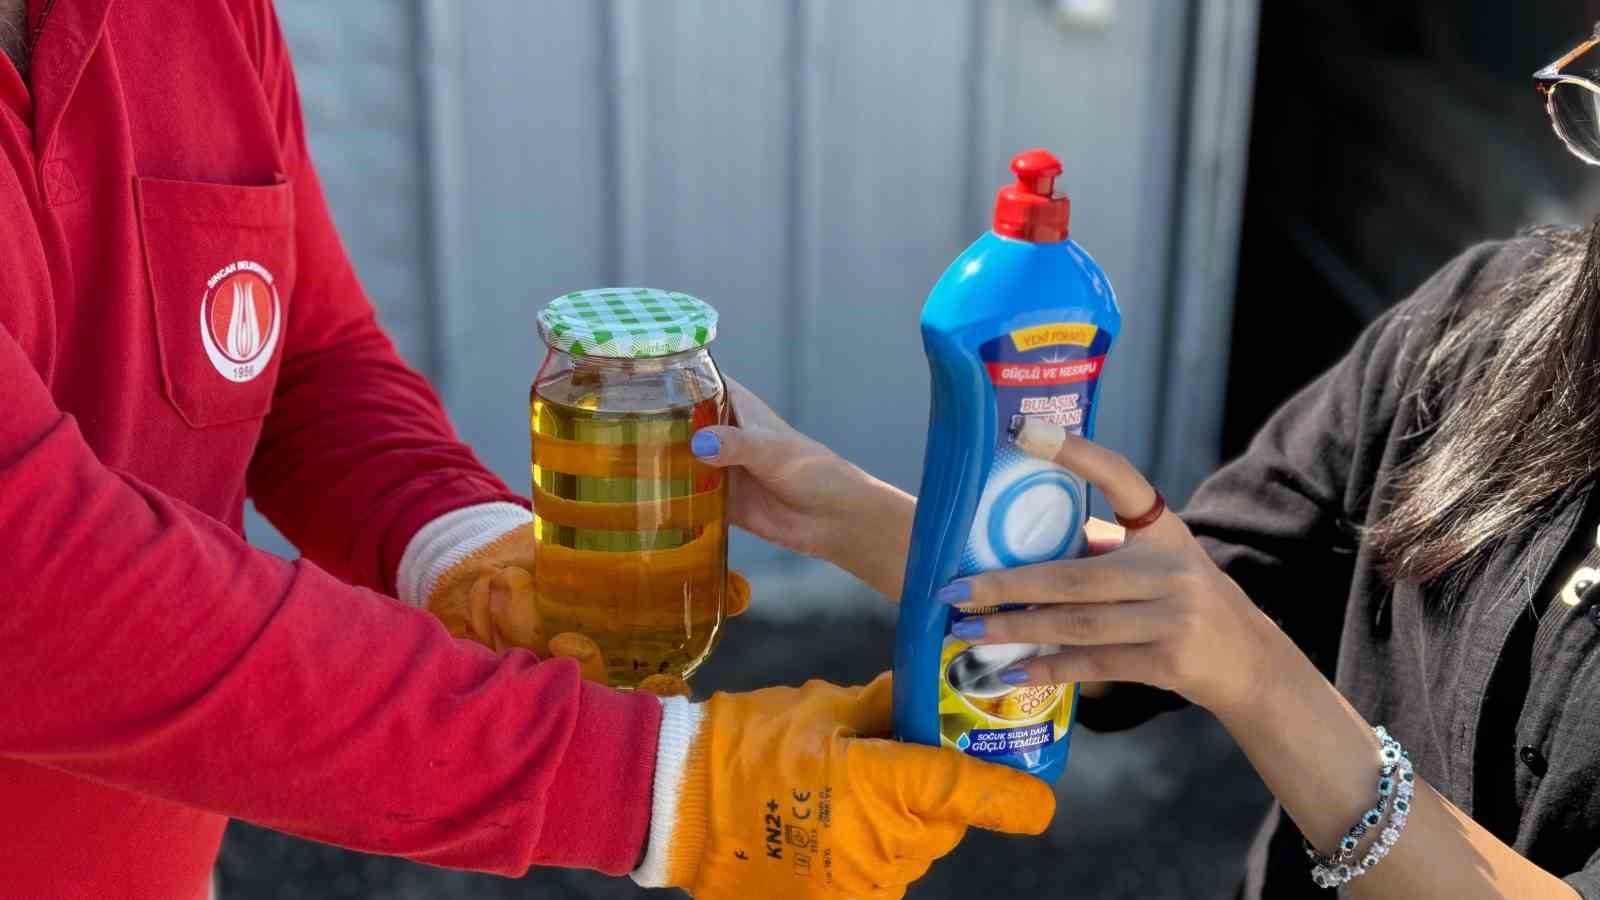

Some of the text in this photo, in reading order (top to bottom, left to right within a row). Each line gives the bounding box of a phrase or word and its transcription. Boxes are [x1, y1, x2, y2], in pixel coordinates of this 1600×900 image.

[1001, 360, 1098, 382] GÜÇLÜ VE HESAPLI
[1020, 394, 1079, 413] BULAŞIK
[972, 732, 1050, 753] GÜÇLÜ TEMİZLİK
[977, 731, 1006, 741] SOĞUK
[1007, 730, 1028, 740] SUDA
[764, 799, 782, 860] KN2+
